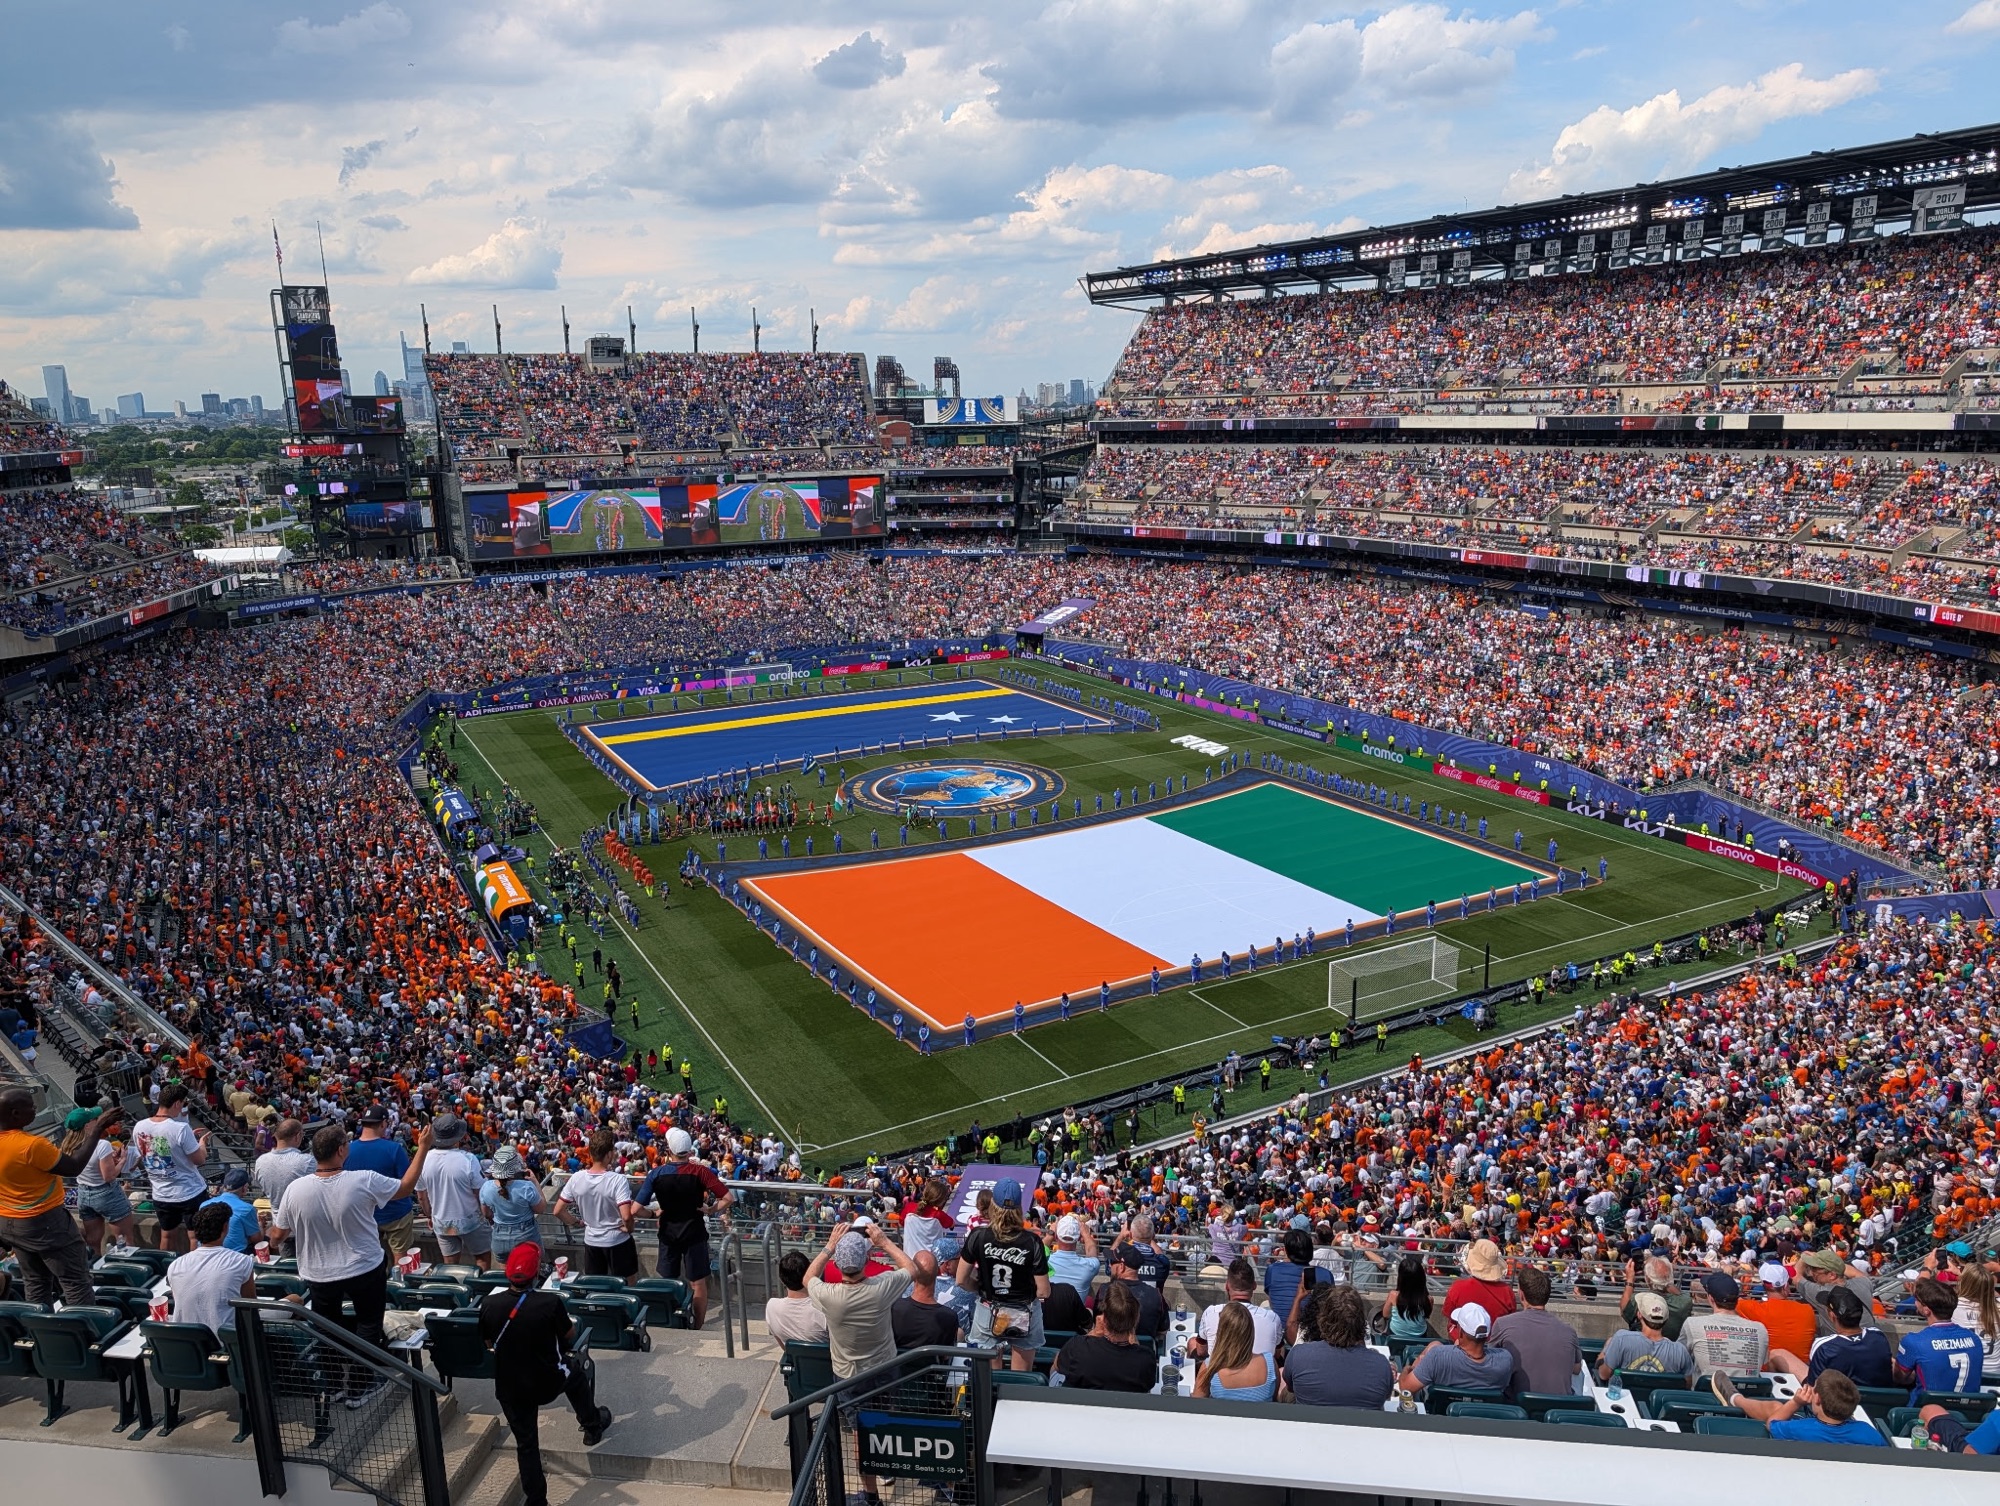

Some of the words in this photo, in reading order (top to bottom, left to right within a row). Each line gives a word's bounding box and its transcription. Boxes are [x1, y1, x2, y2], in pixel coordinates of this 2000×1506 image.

[1936, 193, 1958, 204] 2017
[1854, 206, 1874, 217] 2013
[1934, 207, 1955, 215] WORLD
[1809, 213, 1826, 222] 2010
[1927, 213, 1960, 223] CHAMPIONS
[1723, 225, 1741, 233] 2004
[1765, 219, 1783, 228] 2006
[1648, 235, 1664, 243] 2002
[1685, 230, 1701, 239] 2003
[1614, 239, 1628, 247] 2001
[726, 560, 741, 568] FIFA
[742, 559, 769, 567] WORLD
[491, 576, 510, 584] FIFA
[510, 574, 541, 583] WORLD
[541, 572, 557, 581] CUP
[559, 571, 588, 580] 2026
[1402, 570, 1450, 581] PHILADELPHIA
[1538, 586, 1557, 594] WORLD
[1566, 590, 1584, 598] 2026
[245, 605, 260, 613] FIFA
[260, 603, 281, 612] WORLD
[282, 601, 294, 609] CUP
[294, 598, 315, 606] 2026
[1679, 604, 1753, 619] PHILADELPHIA
[1941, 612, 1956, 621] CÔTE
[965, 653, 991, 662] Lenovo
[1020, 650, 1034, 660] ADI
[1076, 665, 1093, 676] QATAR
[638, 686, 660, 696] VISA
[1133, 680, 1147, 691] VISA
[1159, 688, 1173, 699] VISA
[539, 697, 569, 708] QATAR
[572, 691, 610, 704] AIRWAYS
[465, 708, 482, 718] ADI
[483, 702, 533, 714] PREDICTSTREET
[1267, 719, 1278, 727] FIFA
[1278, 722, 1293, 732] WORLD
[1293, 725, 1303, 734] CUP
[1303, 729, 1322, 739] 2026
[1362, 743, 1404, 764] aramco
[1535, 760, 1551, 771] FIFA
[1438, 765, 1462, 780] Coca-Cola
[1476, 776, 1500, 791] Coca-Cola
[1514, 787, 1541, 803] Coca-Cola
[1709, 841, 1756, 864] Lenovo
[1778, 860, 1819, 886] Lenovo
[984, 1242, 1030, 1265] Coca-Cola
[1931, 1337, 1975, 1350] GRIEZMANN
[1948, 1353, 1970, 1392] 7
[869, 1433, 955, 1460] MLPD
[871, 1461, 890, 1469] Seats
